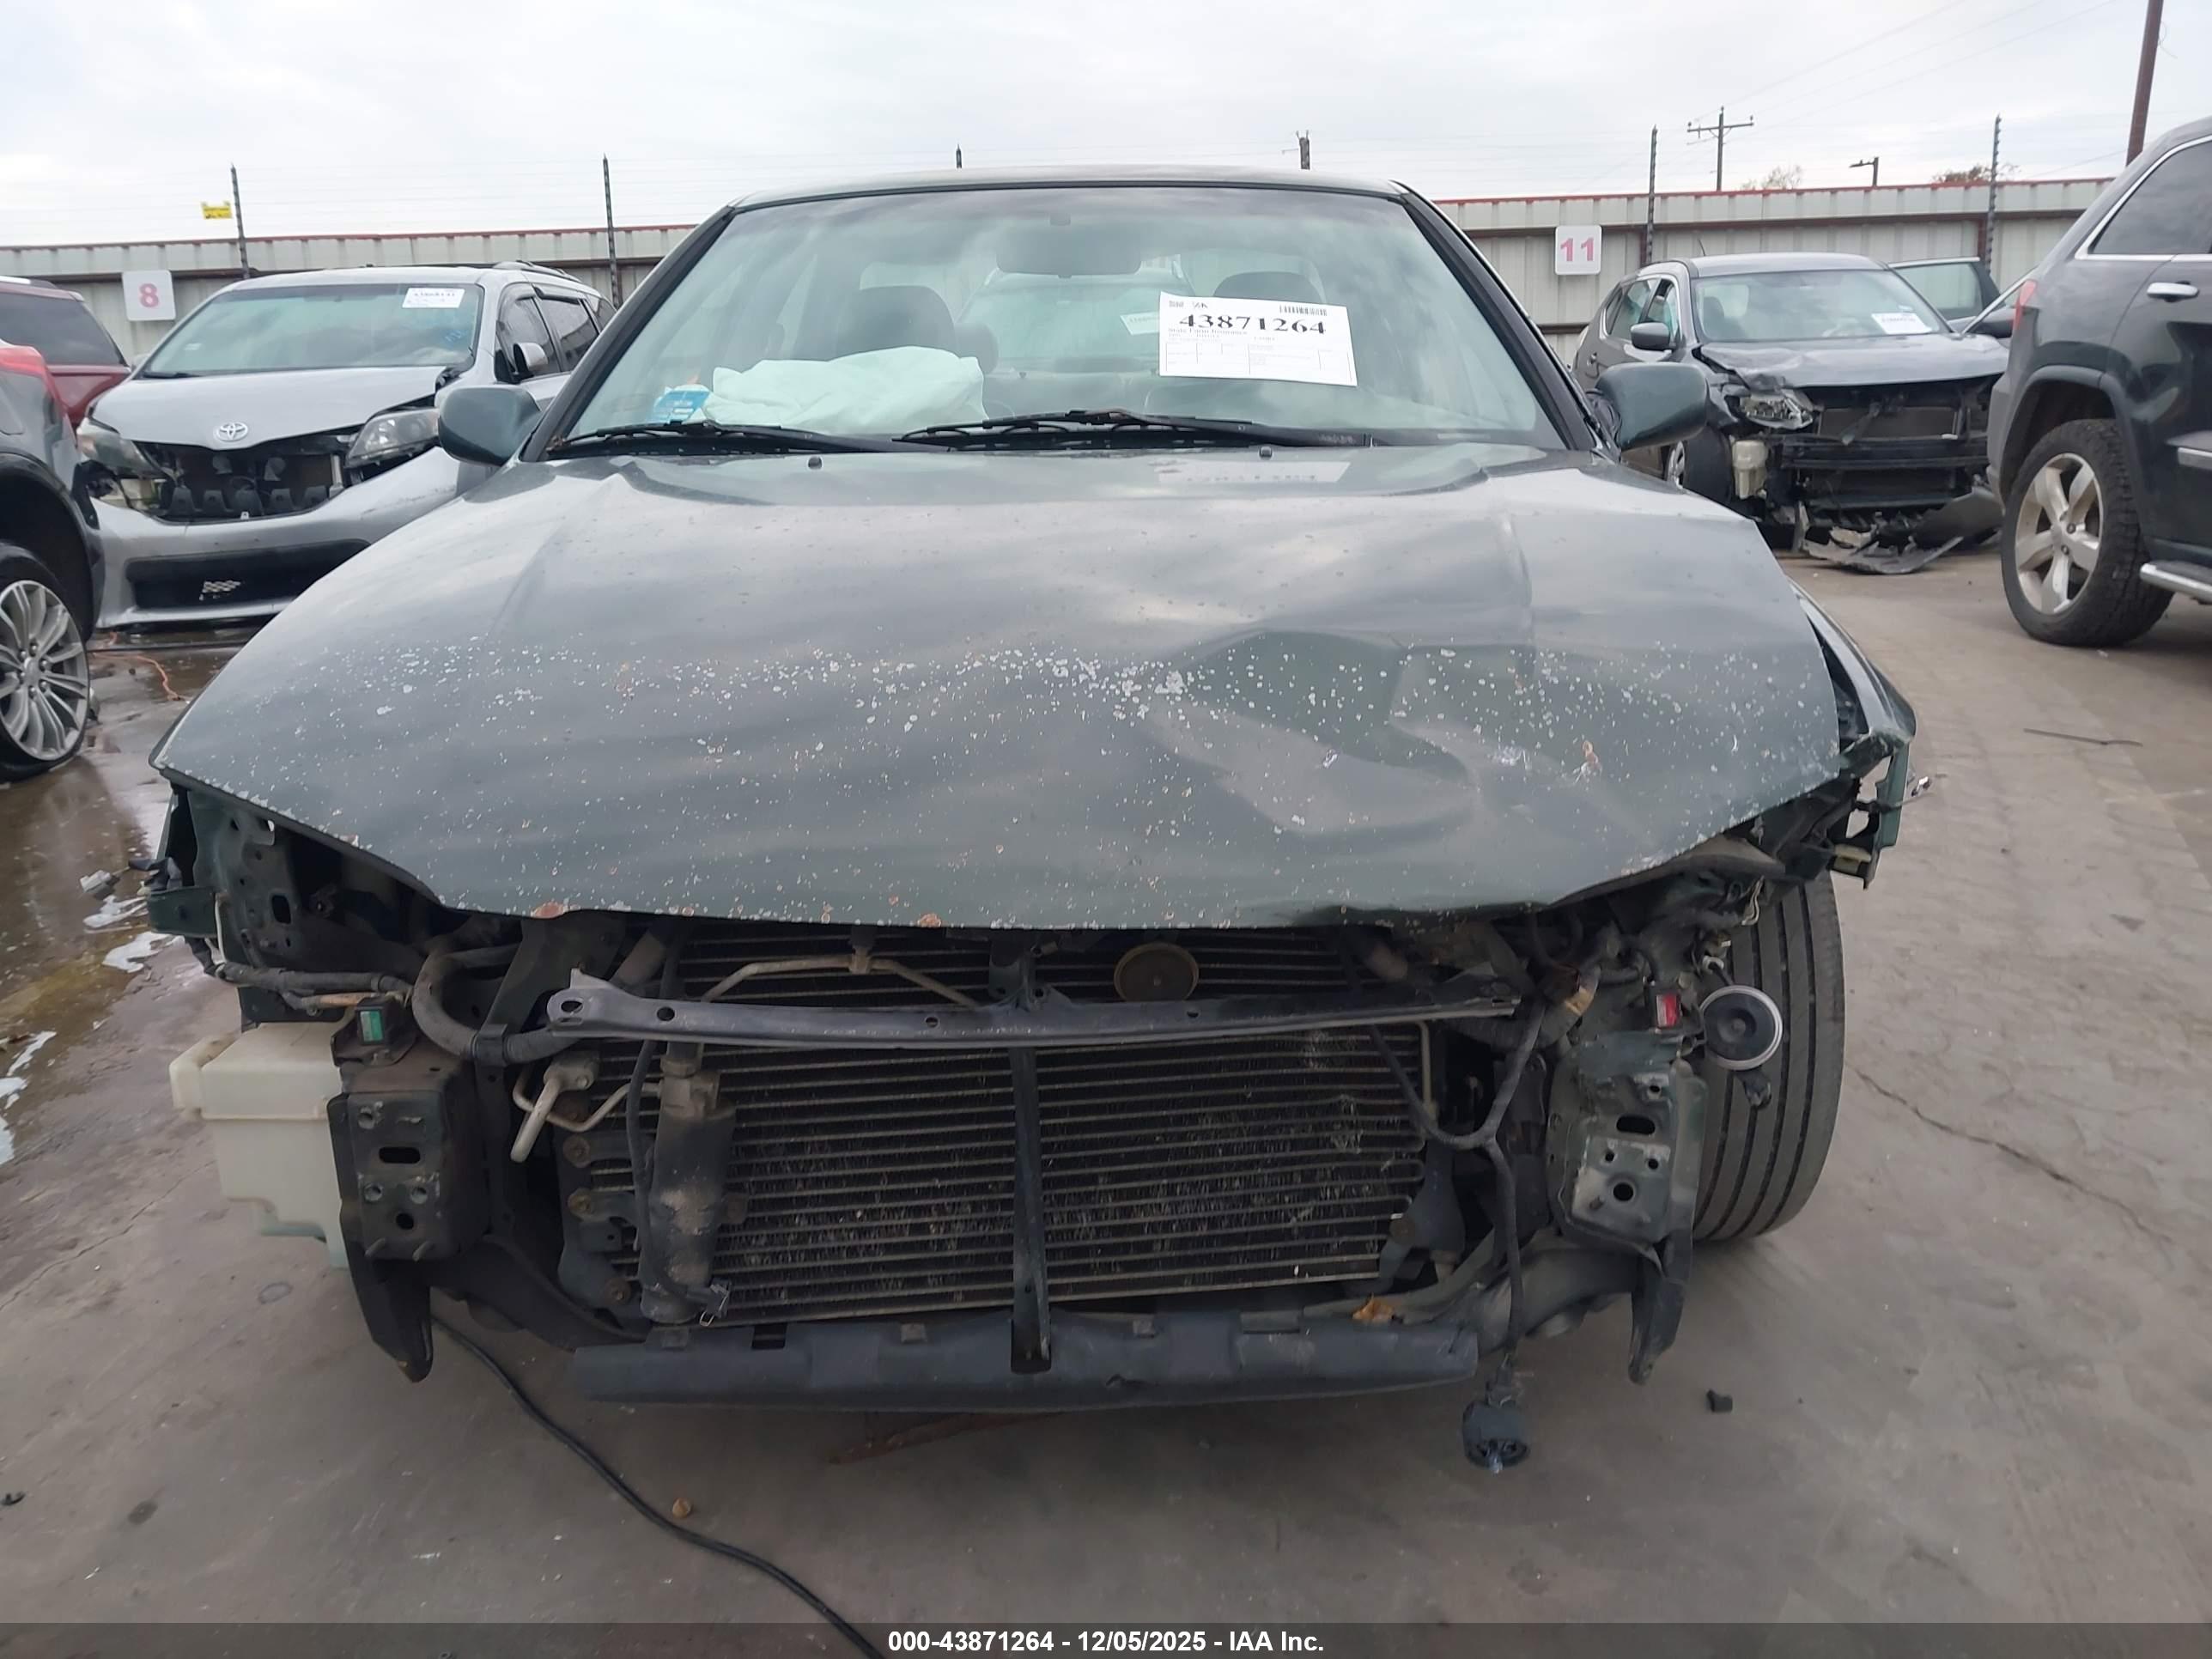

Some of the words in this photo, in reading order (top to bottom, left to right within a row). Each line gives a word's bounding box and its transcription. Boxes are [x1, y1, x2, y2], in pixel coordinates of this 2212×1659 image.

[1559, 237, 1595, 262] 11
[139, 283, 160, 308] 8
[1179, 313, 1327, 335] 43871264
